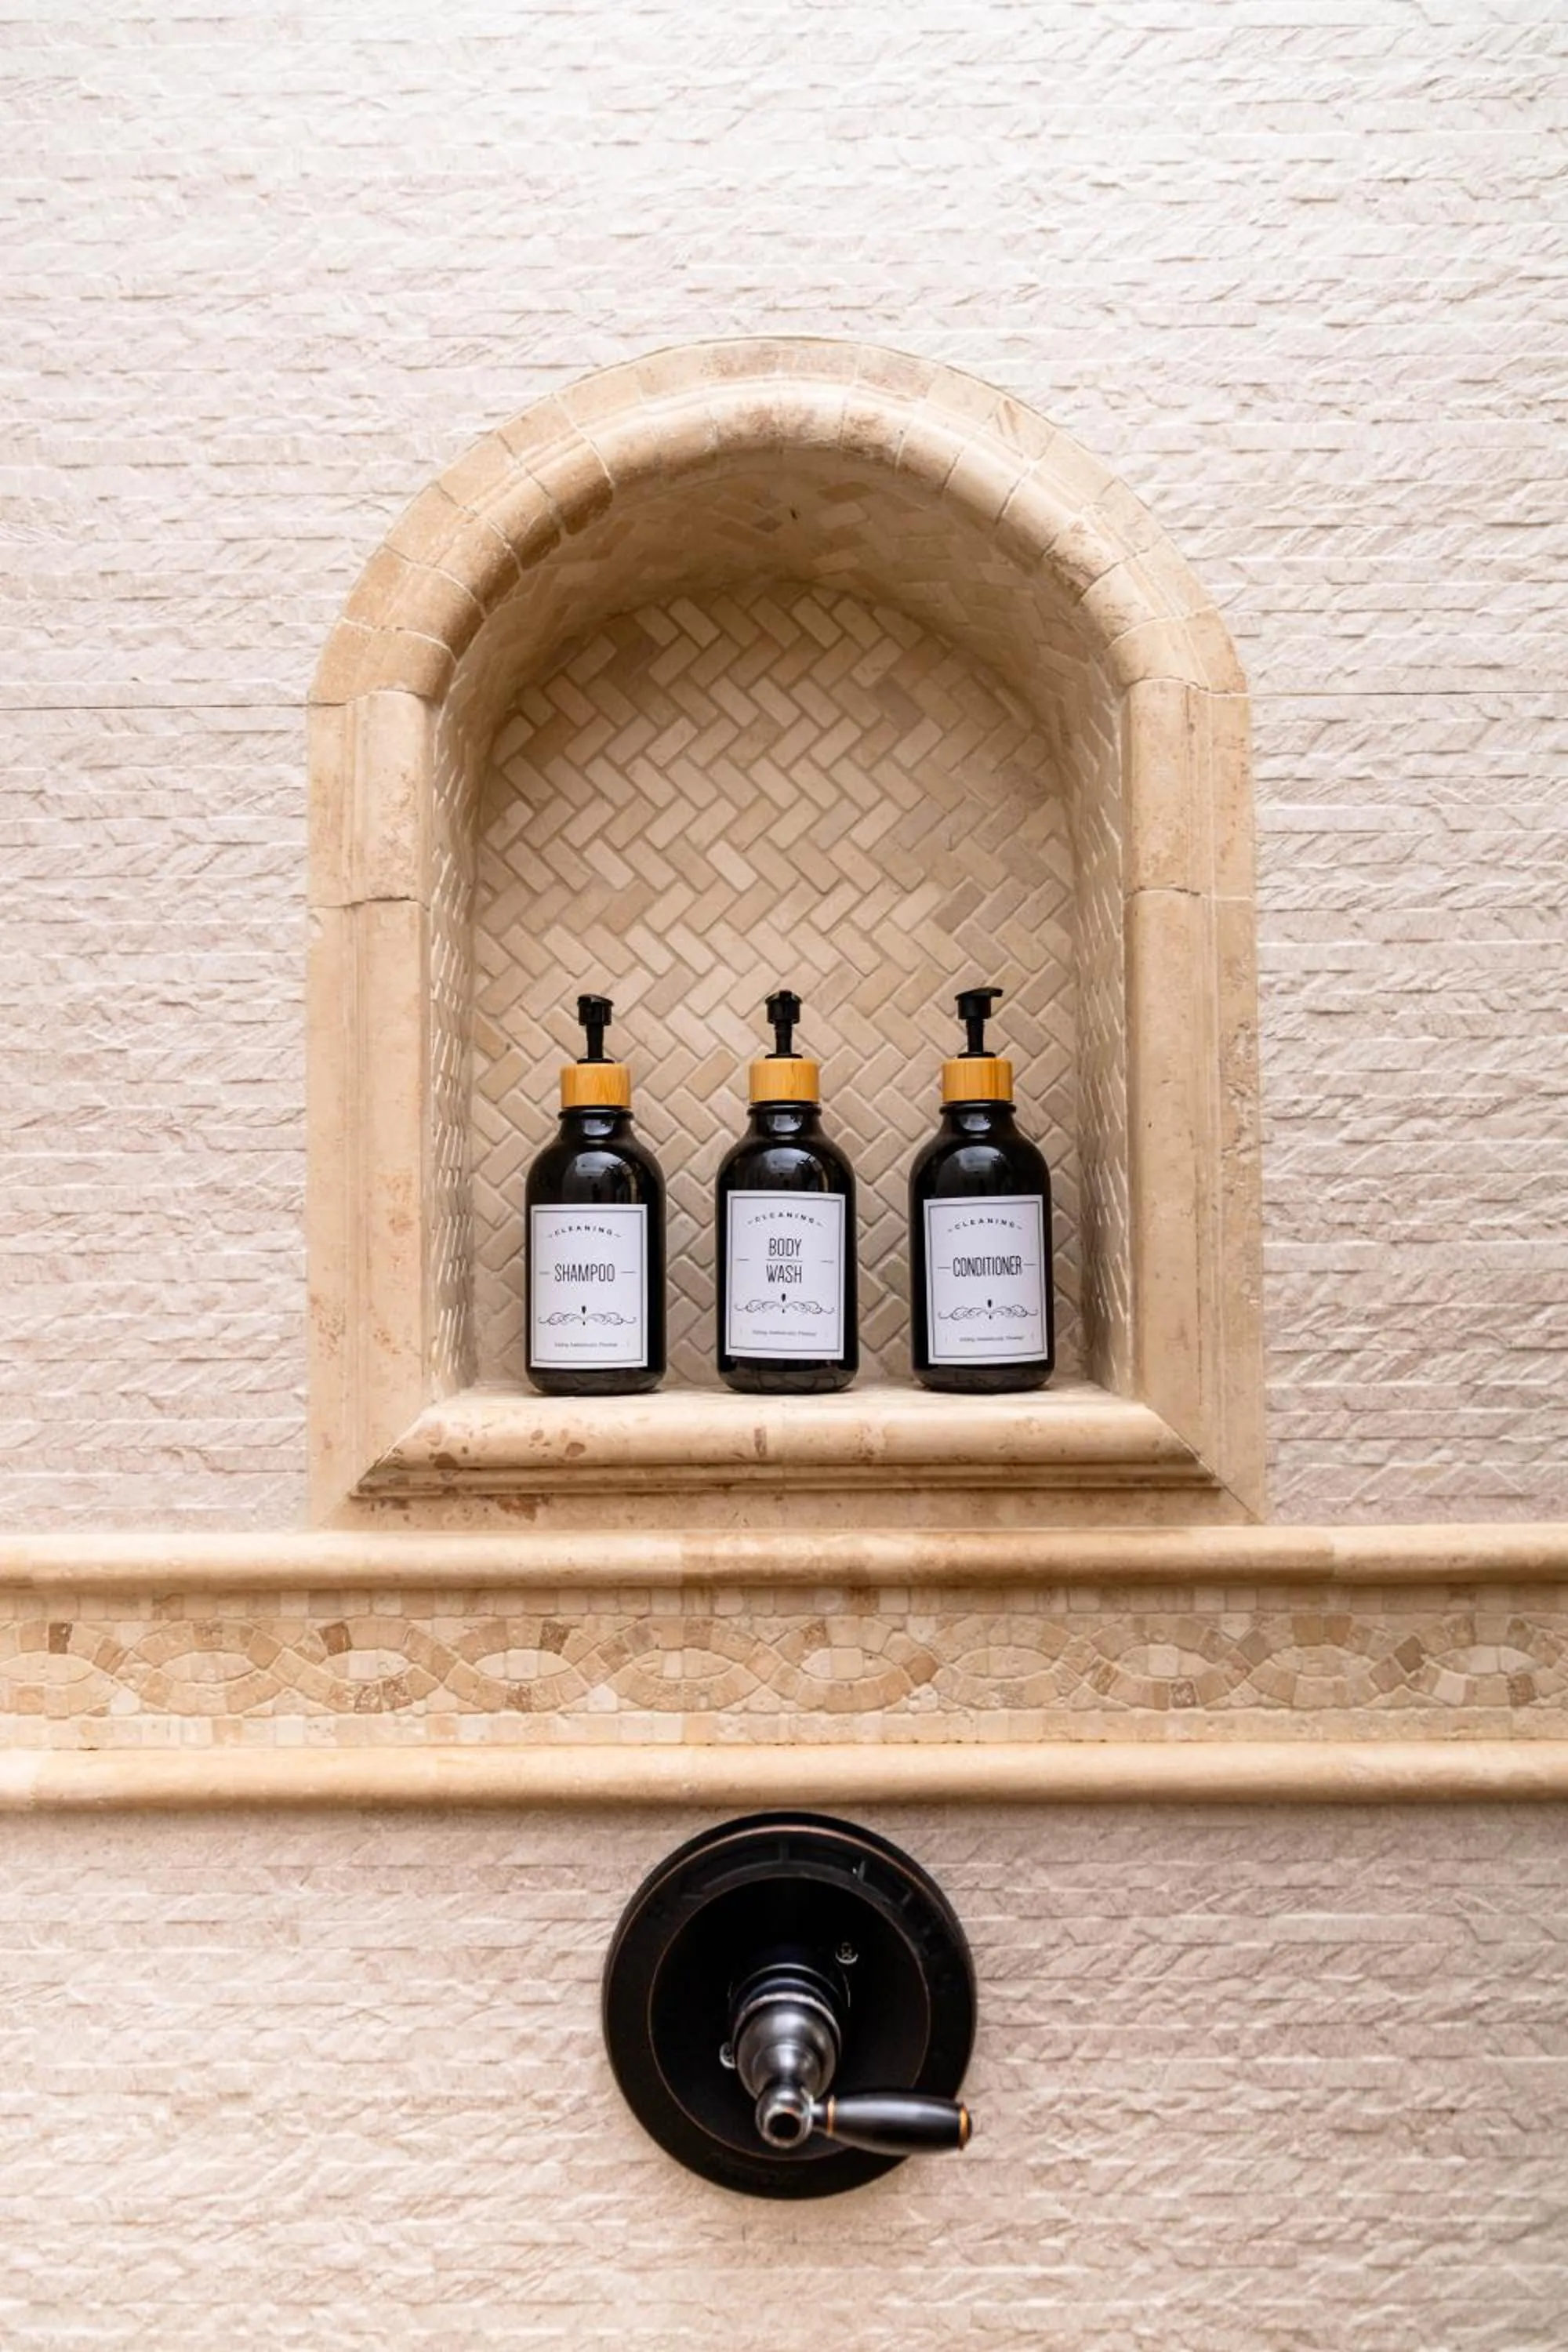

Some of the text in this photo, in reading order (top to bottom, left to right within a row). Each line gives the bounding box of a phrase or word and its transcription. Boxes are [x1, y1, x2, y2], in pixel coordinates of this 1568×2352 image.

[554, 1225, 613, 1236] CLEANING
[768, 1238, 802, 1256] BODY
[554, 1263, 615, 1283] SHAMPOO
[766, 1265, 803, 1283] WASH
[953, 1255, 1023, 1278] CONDITIONER
